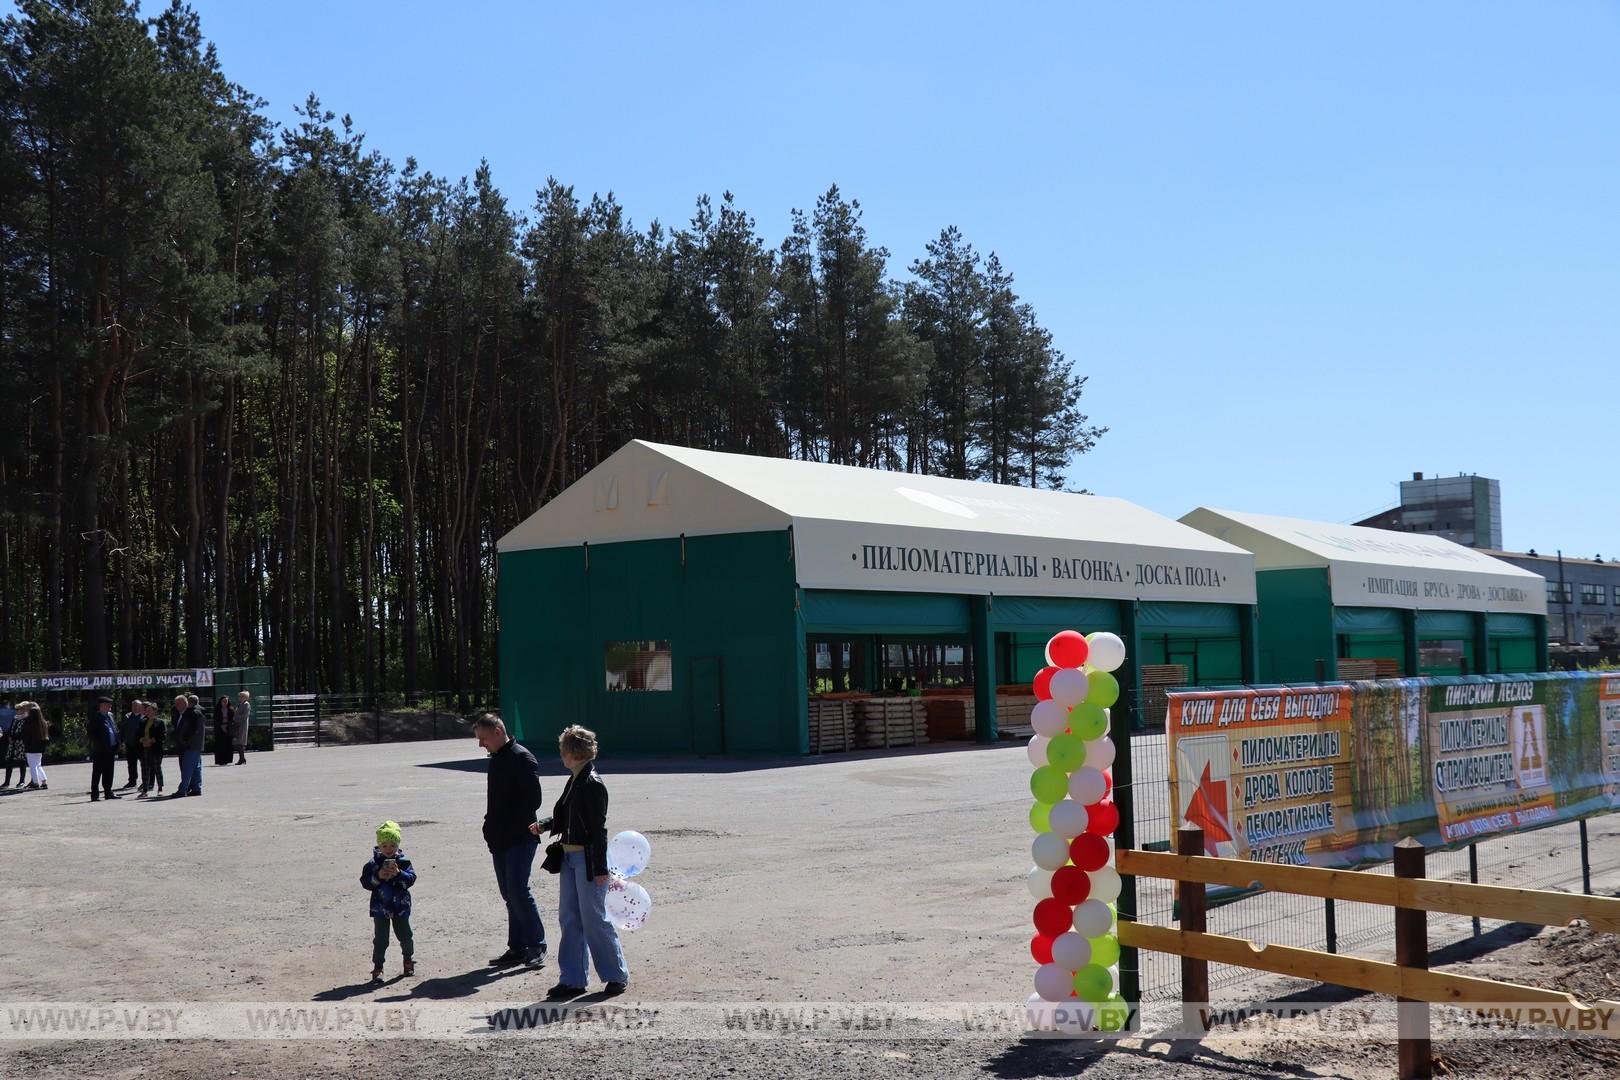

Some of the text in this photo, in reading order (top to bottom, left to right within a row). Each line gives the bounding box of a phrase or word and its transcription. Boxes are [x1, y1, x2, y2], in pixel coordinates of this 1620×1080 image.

[861, 545, 1222, 588] ПИЛОМАТЕРИАЛЫ ВАГОНКА ДОСКА ПОЛА
[41, 677, 89, 688] РАСТЕНИЯ
[93, 676, 113, 687] ДЛЯ
[116, 675, 152, 686] ВАШЕГО
[156, 674, 193, 685] УЧАСТКА
[1497, 682, 1534, 703] ЛЕСХОЗ
[1181, 700, 1215, 726] КУПИ
[1218, 698, 1247, 727] ДЛЯ
[1251, 696, 1281, 721] СЕБЯ
[1241, 731, 1341, 766] ПИЛОМАТЕРИАЛЫ
[1244, 766, 1334, 808] ДРОВА КОЛОТЫЕ
[1246, 801, 1333, 844] ДЕКОРАТИВНЫЕ
